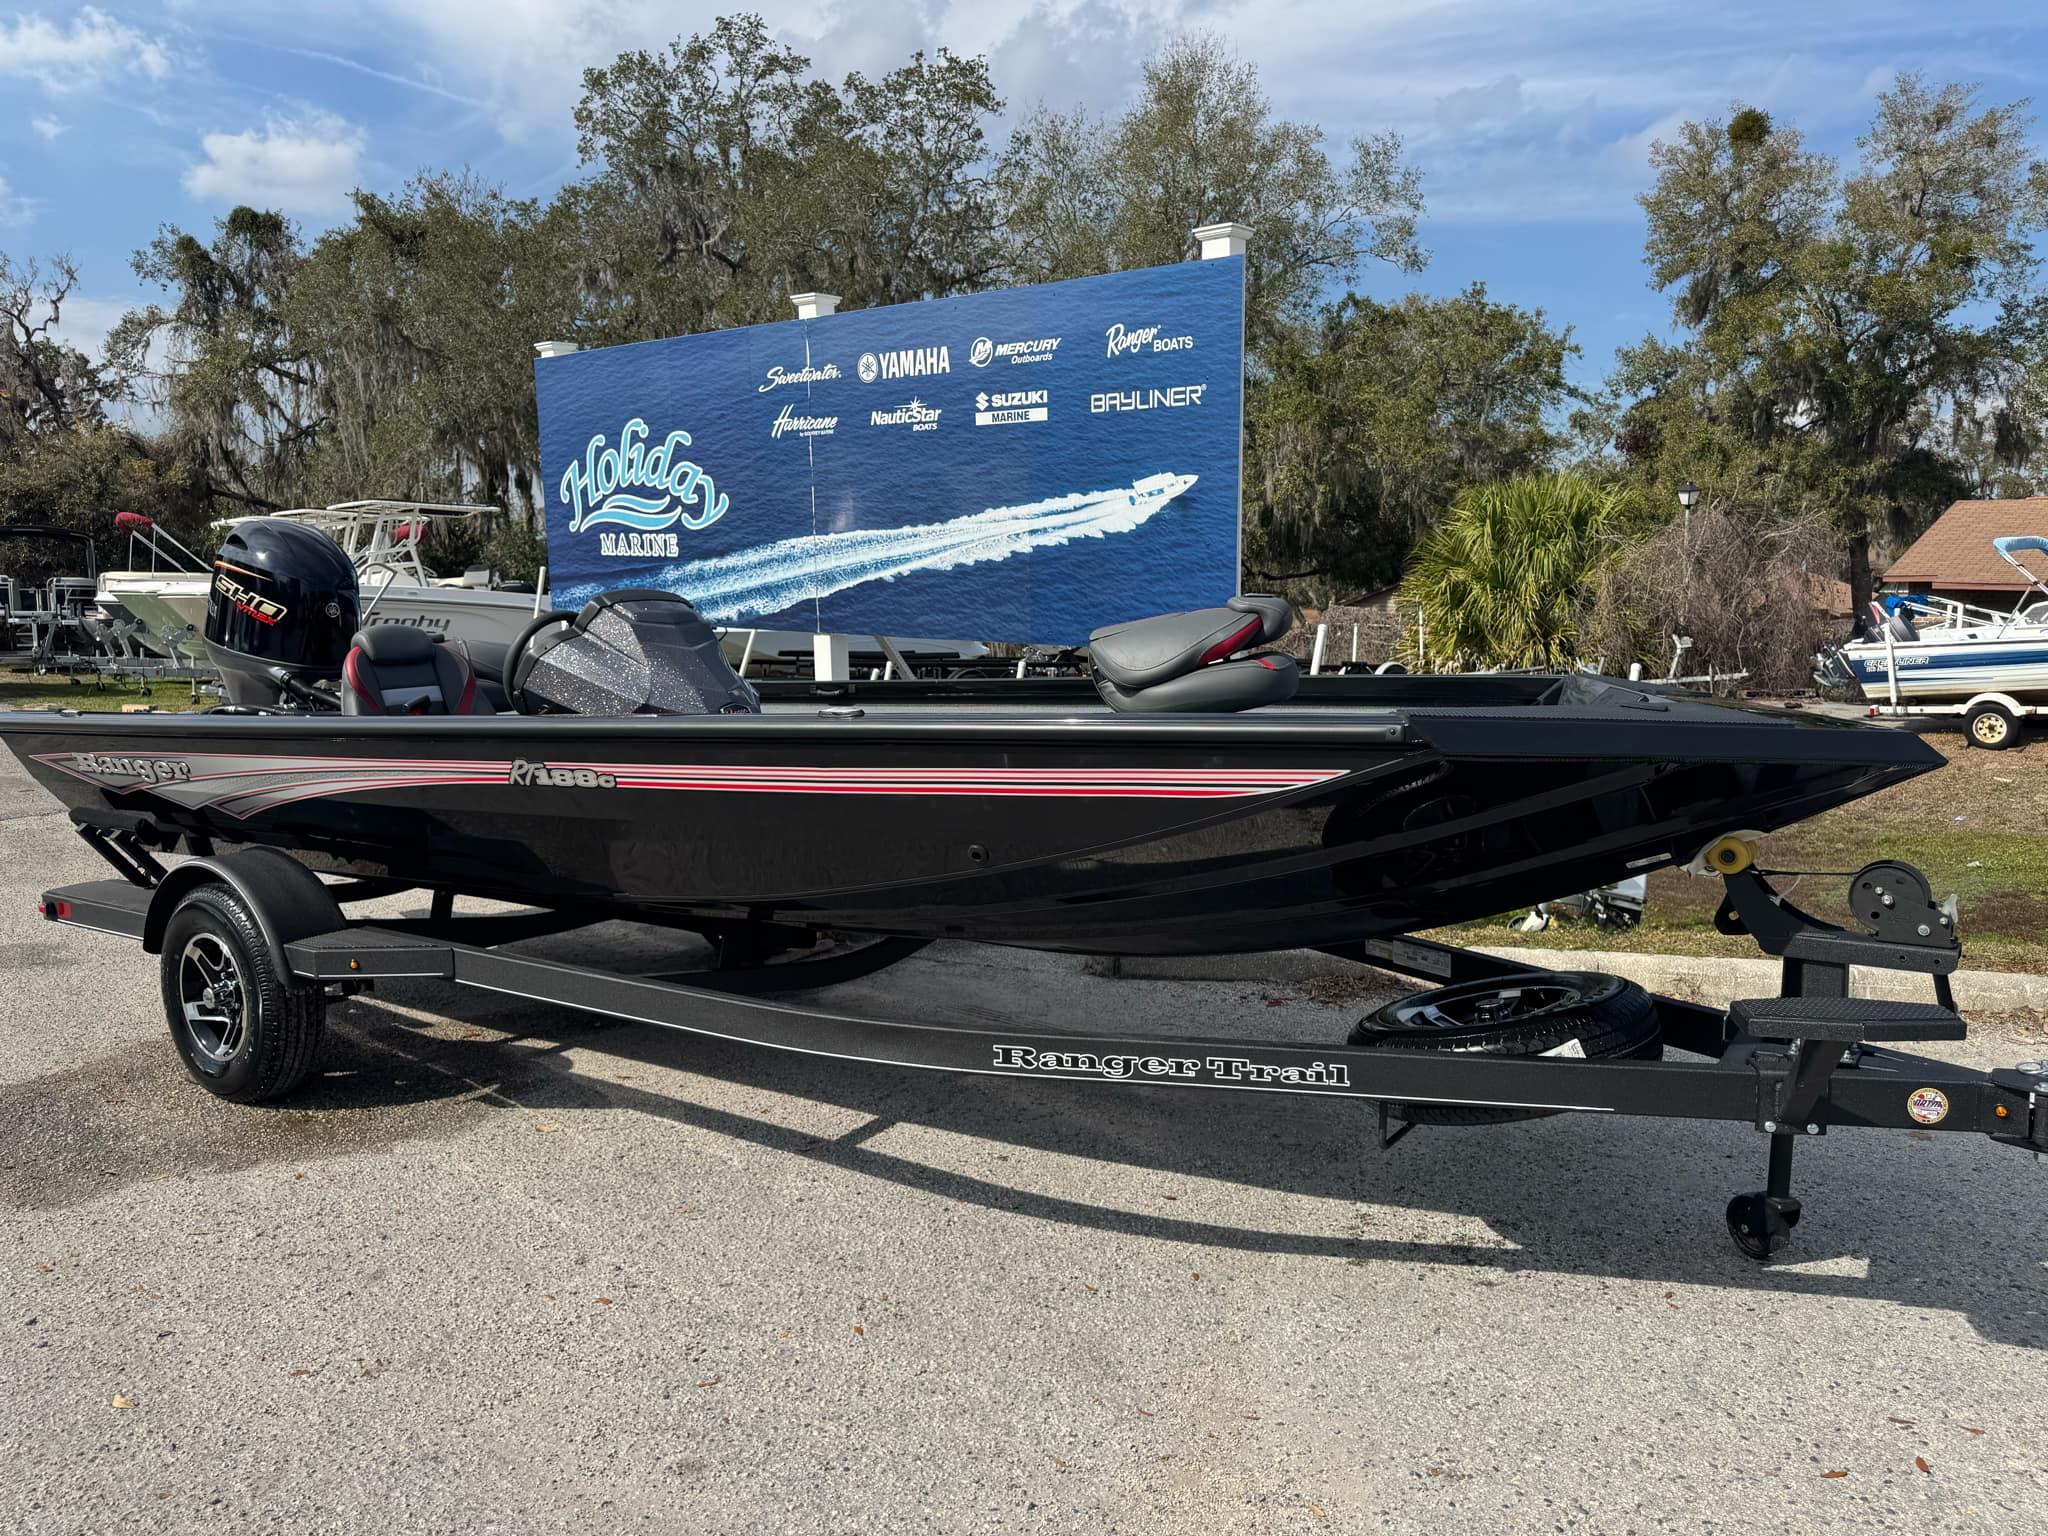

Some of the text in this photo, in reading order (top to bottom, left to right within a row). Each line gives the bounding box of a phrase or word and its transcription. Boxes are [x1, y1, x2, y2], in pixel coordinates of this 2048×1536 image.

[994, 337, 1062, 357] MERCURY
[1105, 323, 1193, 358] Ranger BOATS
[878, 346, 950, 379] YAMAHA
[1011, 352, 1053, 364] Outboards
[991, 390, 1048, 407] SUZUKI
[1090, 385, 1203, 413] BAYLINER
[771, 403, 838, 440] Hurricane
[870, 406, 942, 426] NauticStar
[912, 422, 938, 431] BOATS
[991, 410, 1030, 423] MARINE
[560, 418, 730, 532] Holiday
[600, 533, 679, 557] MARINE
[215, 574, 288, 621] SHO
[72, 752, 192, 784] Ranger
[993, 1044, 1350, 1087] Ranger Trail
